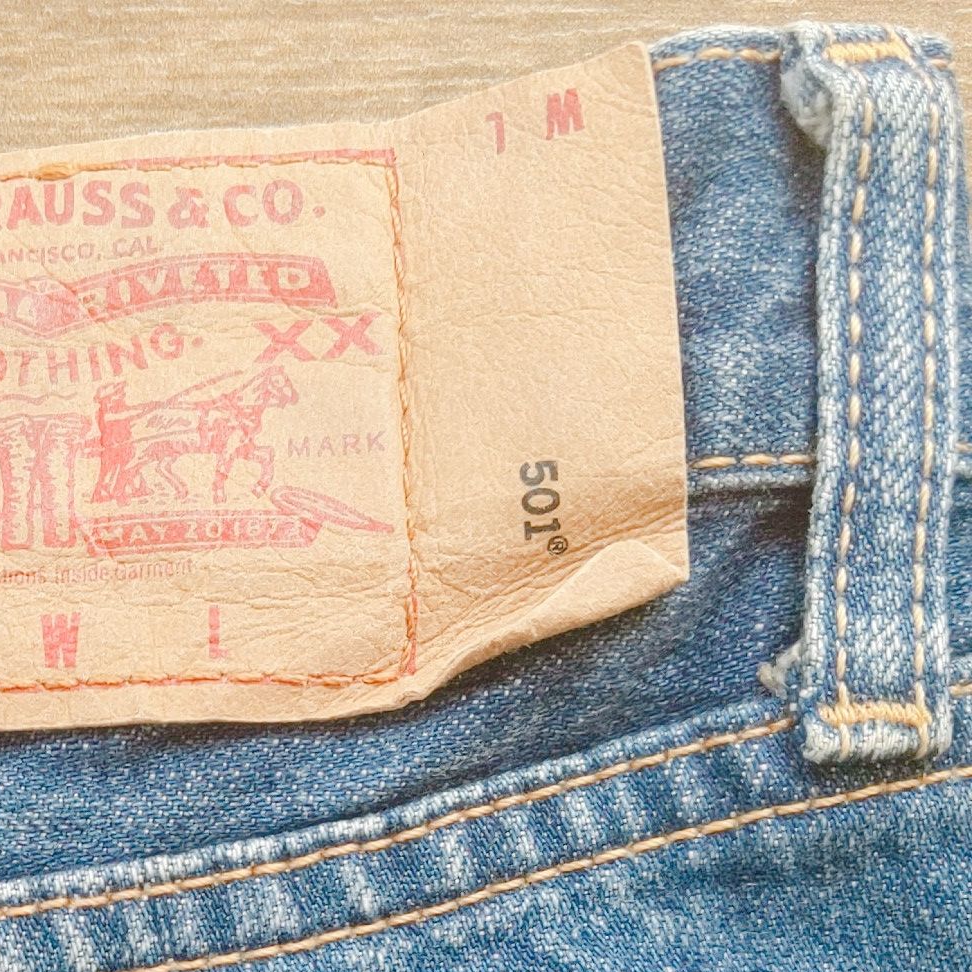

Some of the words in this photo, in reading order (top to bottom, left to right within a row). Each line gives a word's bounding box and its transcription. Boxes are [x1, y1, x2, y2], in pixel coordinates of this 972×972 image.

[167, 186, 210, 229] &
[222, 179, 326, 227] CO.
[287, 430, 387, 458] MARK
[40, 611, 81, 669] W
